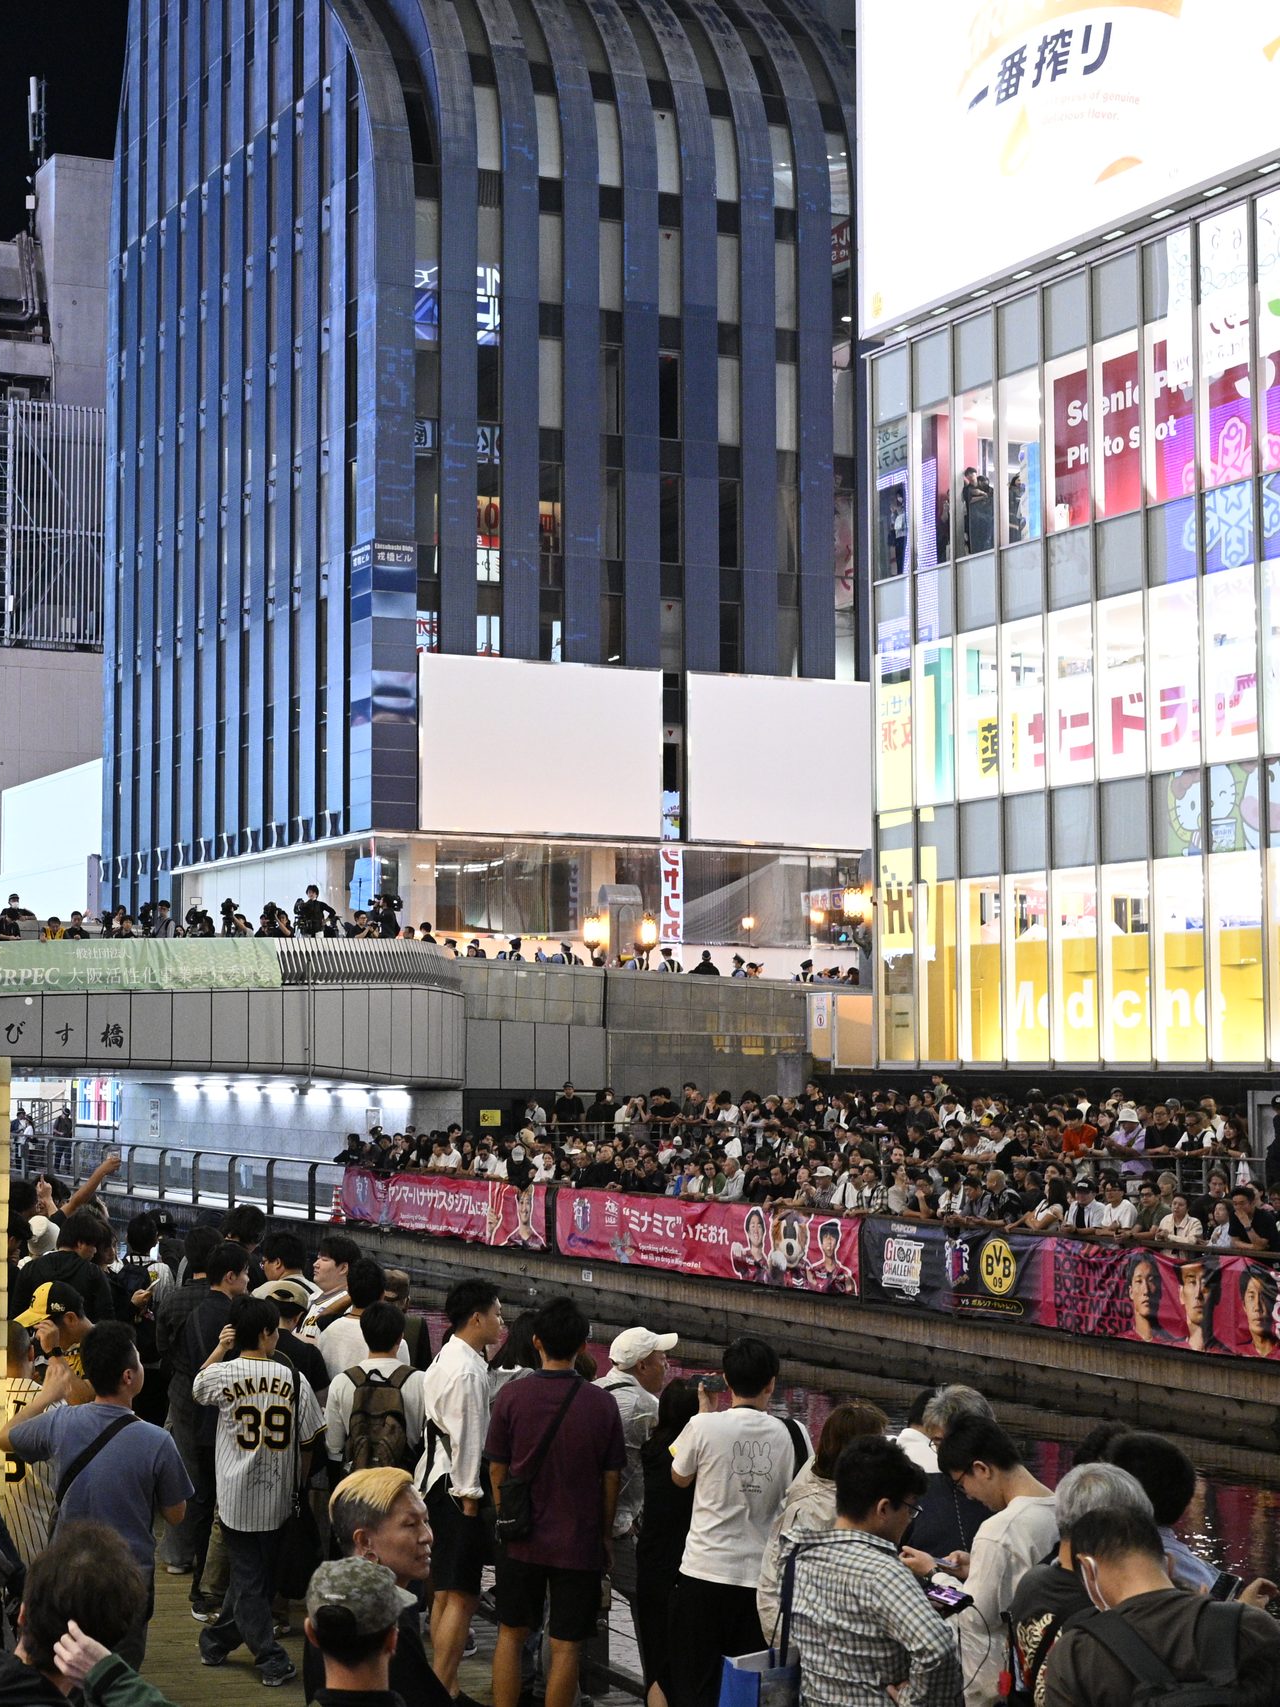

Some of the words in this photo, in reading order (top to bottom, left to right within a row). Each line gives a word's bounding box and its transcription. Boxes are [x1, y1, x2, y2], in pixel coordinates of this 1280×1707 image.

[985, 1245, 1012, 1279] BVB
[992, 1276, 1003, 1289] 09
[1054, 1293, 1133, 1320] DORTMUND
[235, 1405, 291, 1450] 39
